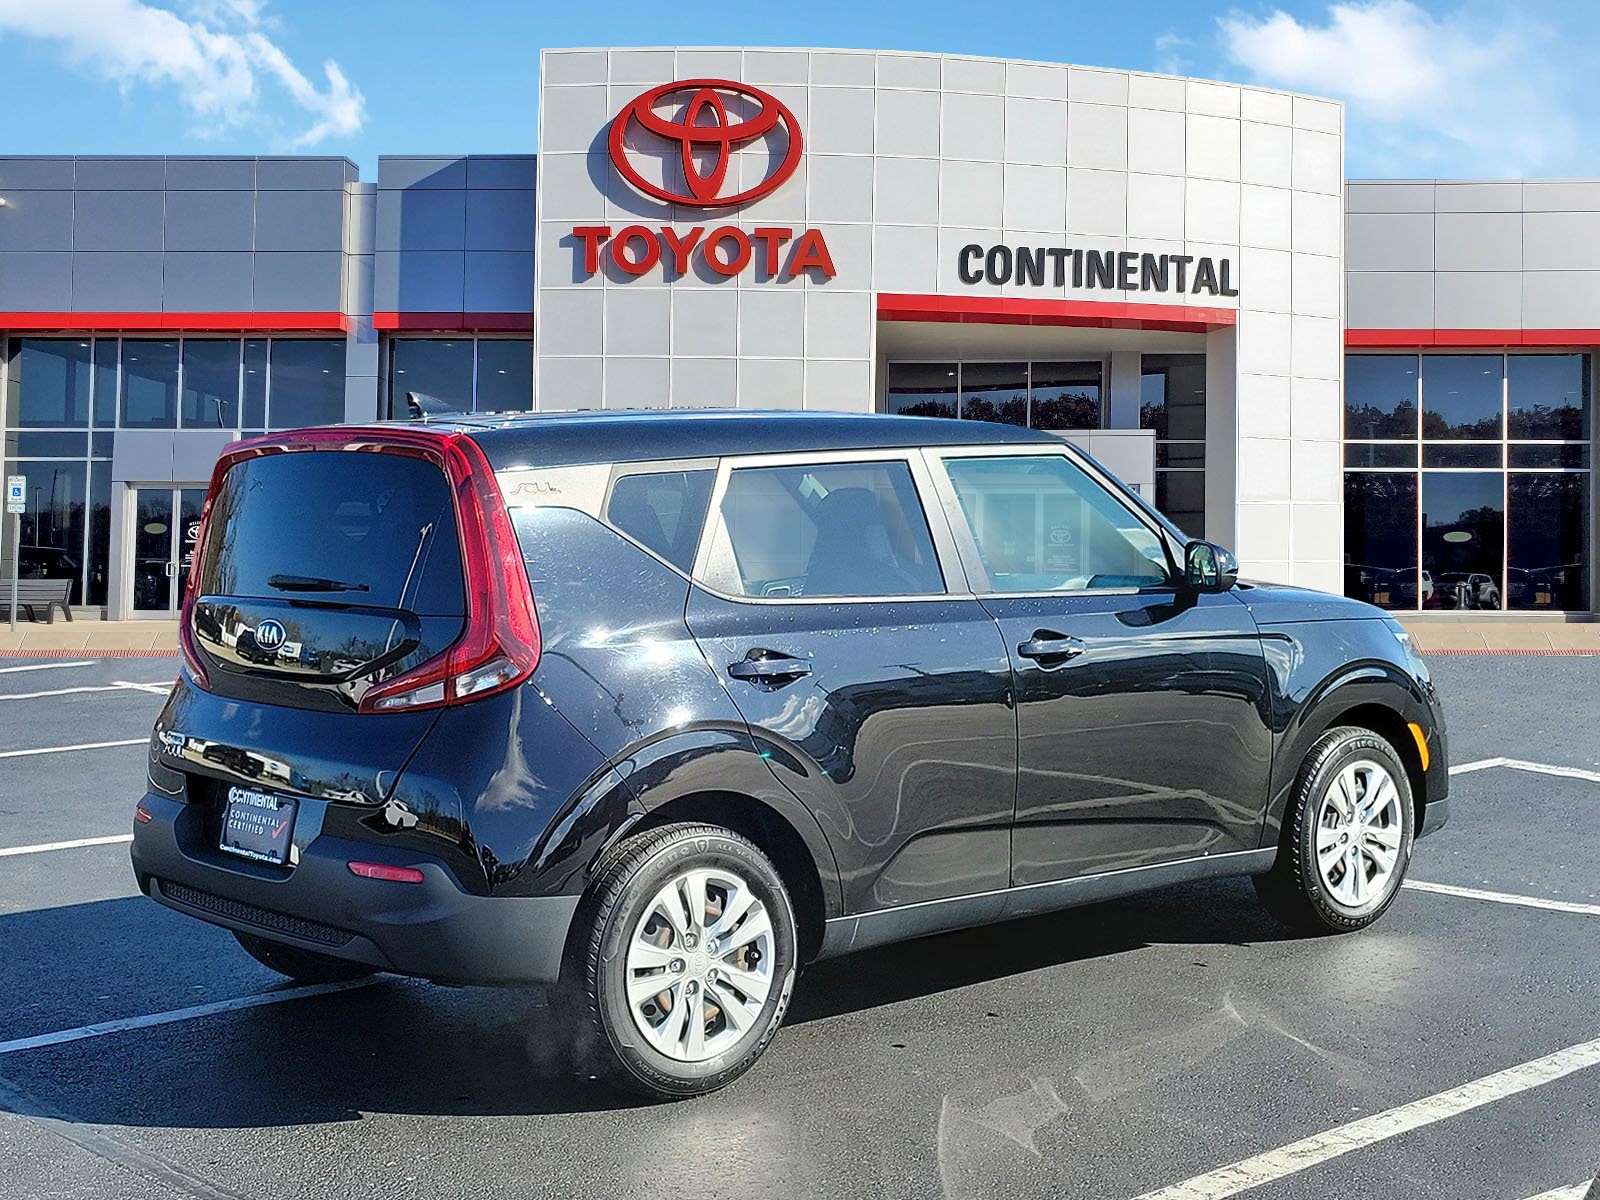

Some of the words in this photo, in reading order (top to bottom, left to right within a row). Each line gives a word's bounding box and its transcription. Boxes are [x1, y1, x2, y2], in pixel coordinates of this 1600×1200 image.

[572, 225, 836, 277] TOYOTA
[959, 244, 1239, 297] CONTINENTAL
[257, 626, 279, 644] KIA
[229, 819, 264, 834] CERTIFIED
[230, 809, 279, 828] CONTINENTAL
